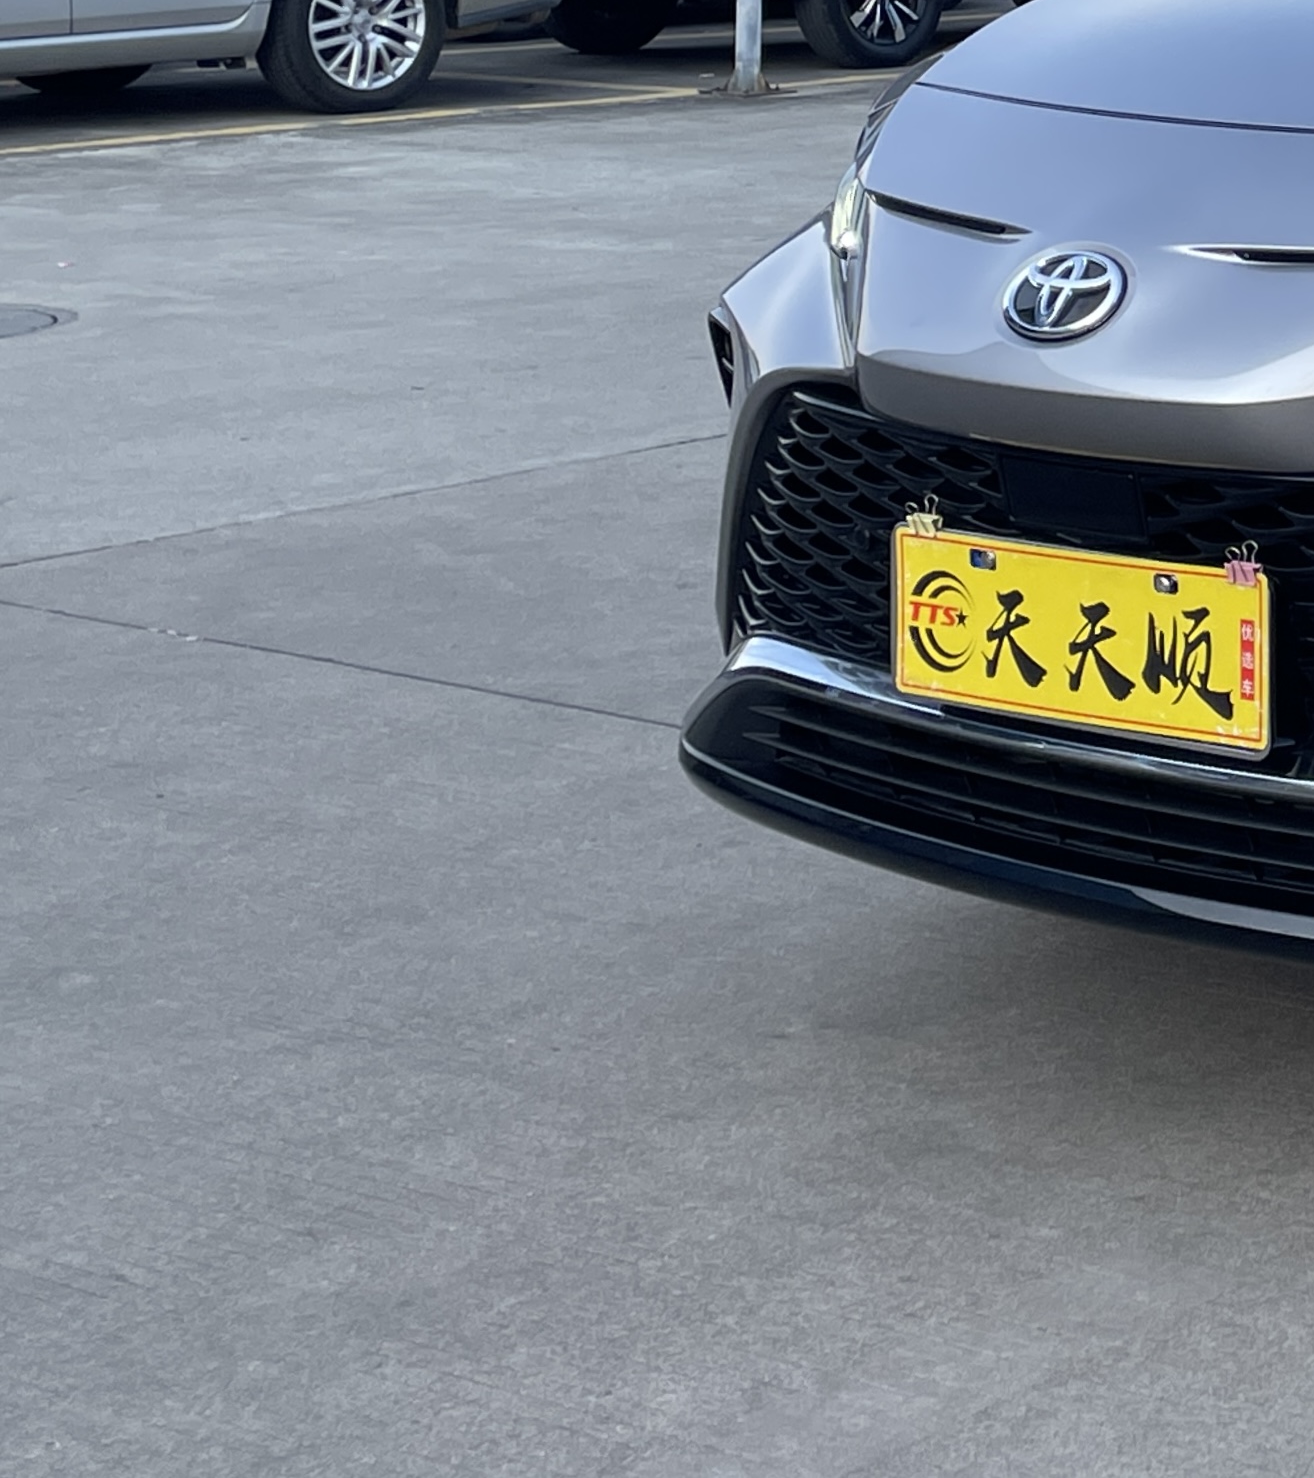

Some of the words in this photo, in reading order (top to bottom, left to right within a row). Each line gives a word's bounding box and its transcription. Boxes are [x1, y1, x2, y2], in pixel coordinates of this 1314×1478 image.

[909, 600, 958, 627] TTS
[982, 589, 1234, 721] 天天顺
[1241, 624, 1255, 695] 优选车
